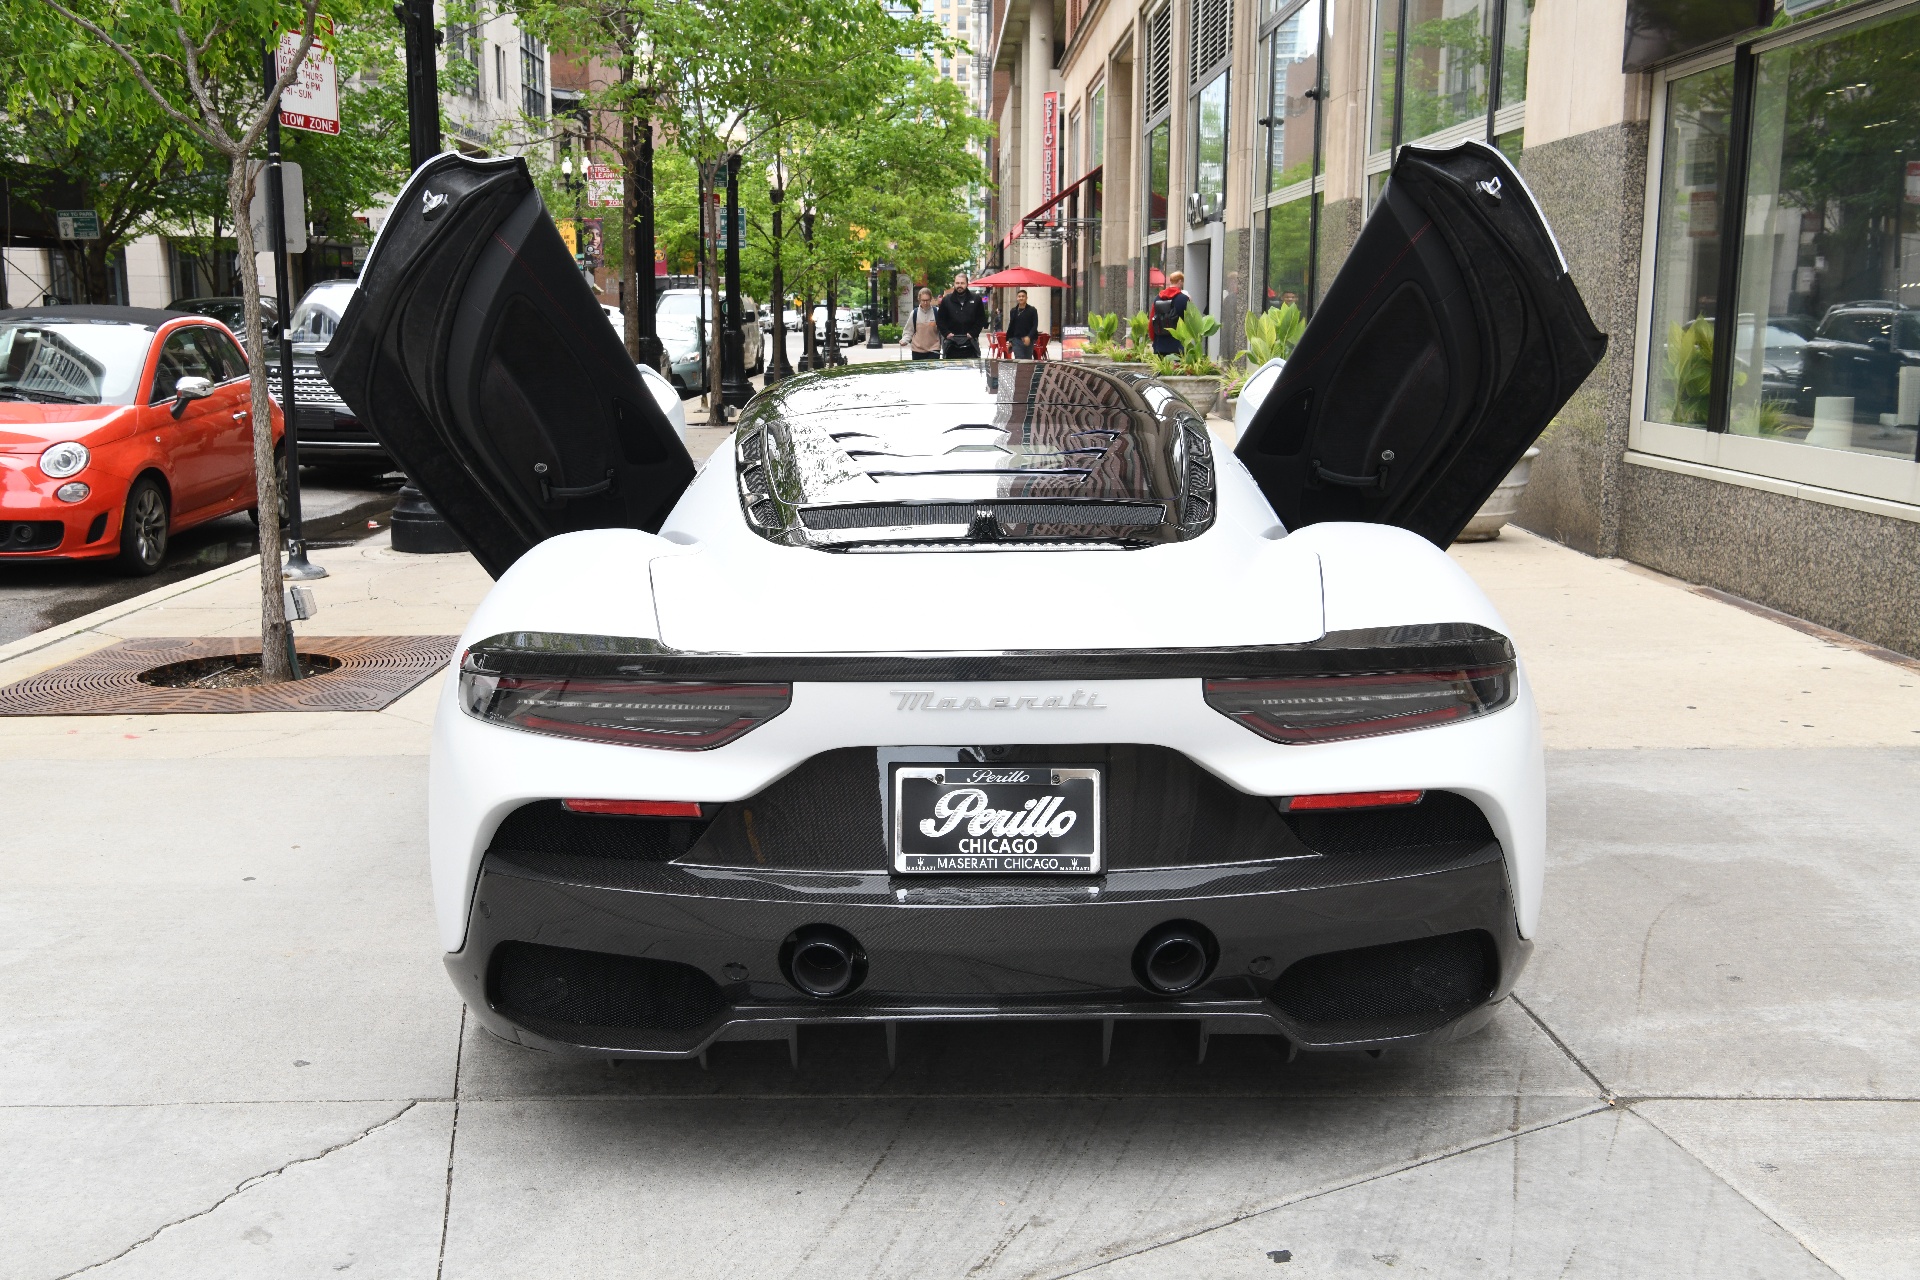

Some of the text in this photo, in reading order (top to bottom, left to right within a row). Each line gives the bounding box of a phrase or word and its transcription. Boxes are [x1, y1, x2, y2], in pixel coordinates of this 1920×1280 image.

[280, 35, 292, 46] USE
[279, 55, 287, 65] 10
[304, 60, 309, 69] 8
[310, 63, 320, 71] PM
[311, 53, 333, 65] LIGTS
[301, 69, 324, 83] THURS
[305, 81, 310, 90] 6
[310, 82, 321, 91] PM
[298, 89, 312, 99] SUN
[283, 112, 335, 133] TOW ZONE
[1044, 98, 1053, 146] EPIC
[889, 688, 1108, 711] Maserati
[966, 769, 1030, 784] Perillo
[919, 788, 1077, 838] Perillo
[958, 838, 1038, 854] CHICAGO
[937, 858, 1059, 870] MASERATI CHICAGO
